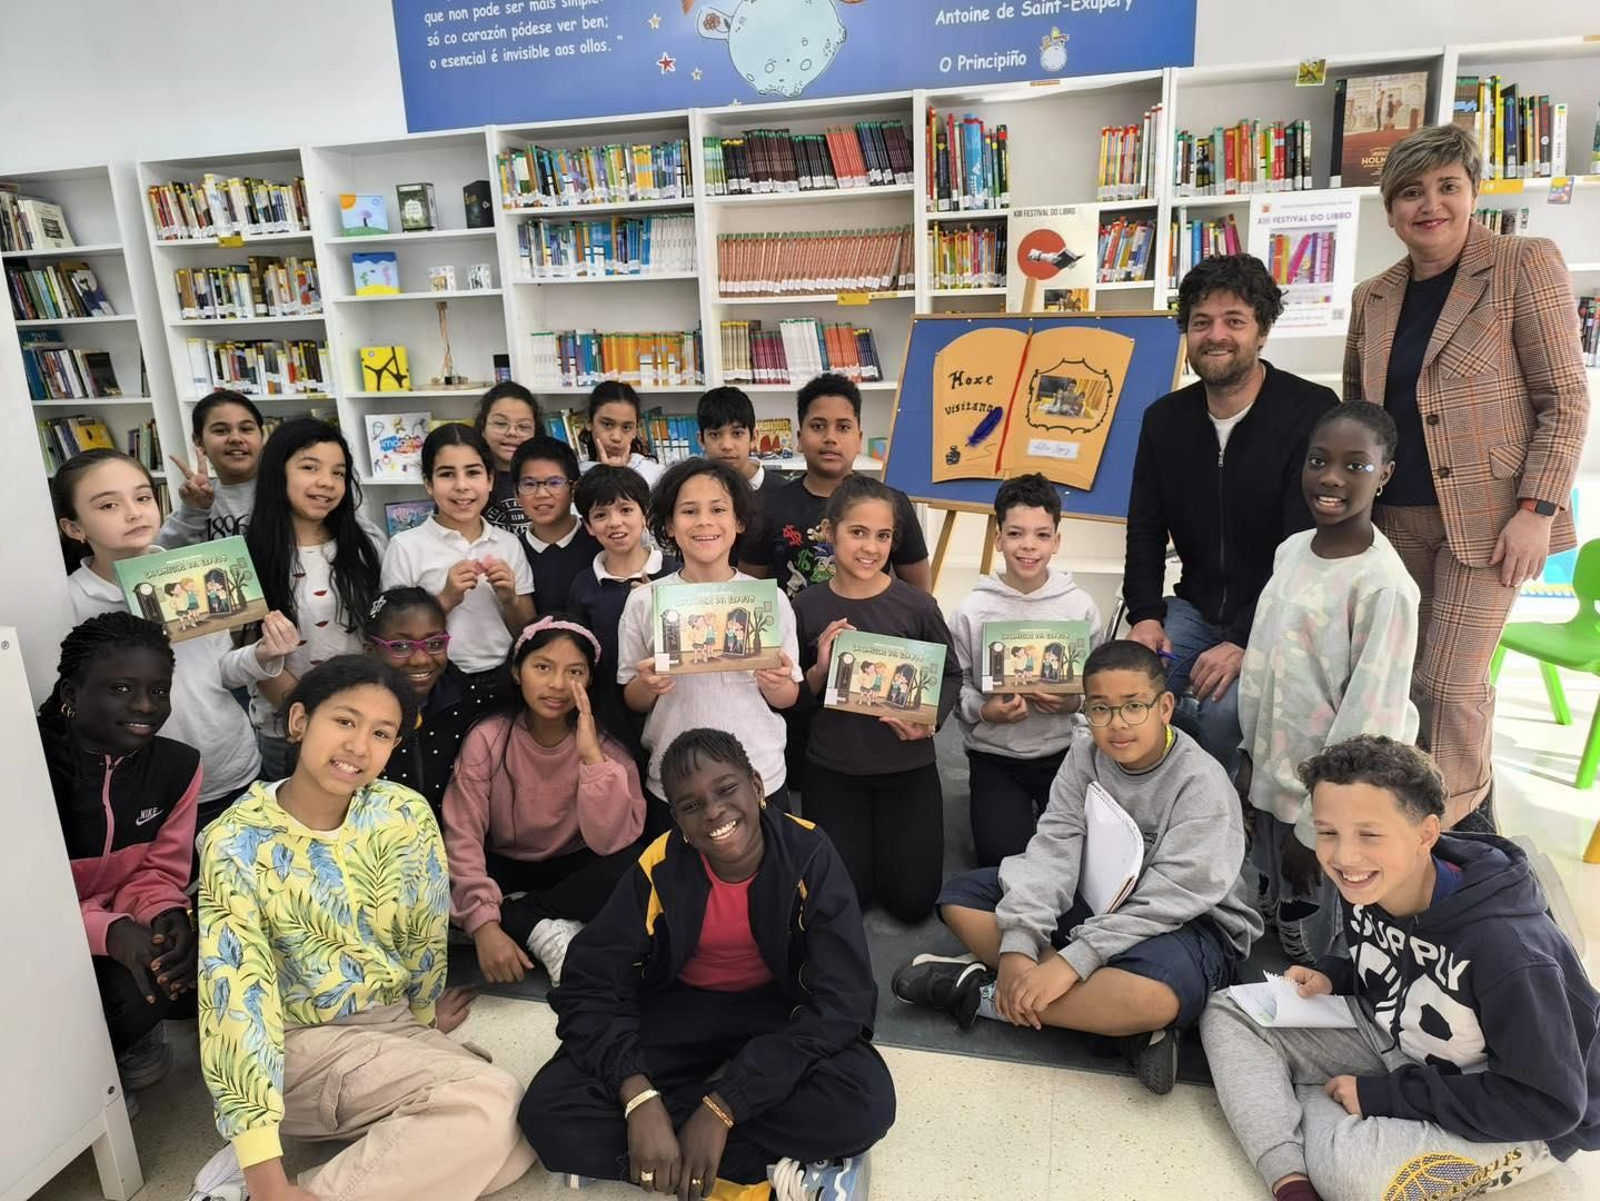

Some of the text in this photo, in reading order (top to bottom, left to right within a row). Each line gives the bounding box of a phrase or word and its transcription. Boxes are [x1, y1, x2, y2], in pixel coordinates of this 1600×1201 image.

[424, 11, 444, 27] que
[449, 8, 468, 21] non
[473, 4, 500, 22] pode
[506, 3, 524, 14] ser
[935, 9, 990, 26] Antoine
[997, 6, 1014, 19] de
[427, 31, 440, 46] só
[444, 34, 457, 44] co
[462, 24, 507, 42] corazón
[511, 21, 552, 41] pódese
[557, 20, 577, 32] ver
[430, 59, 437, 69] o
[441, 49, 487, 68] esencial
[491, 48, 498, 63] é
[503, 44, 550, 62] invisible
[555, 44, 575, 56] aos
[580, 38, 612, 53] ollos.
[939, 50, 1027, 72] O Principiño
[1023, 208, 1049, 217] FESTIVAL
[1050, 208, 1058, 216] DO
[1059, 207, 1076, 216] LIBRO
[1273, 213, 1308, 224] FESTIVAL
[1310, 213, 1324, 222] DO
[1326, 211, 1352, 220] LIBRO
[948, 370, 994, 389] Hoxe
[140, 807, 158, 819] NIKE
